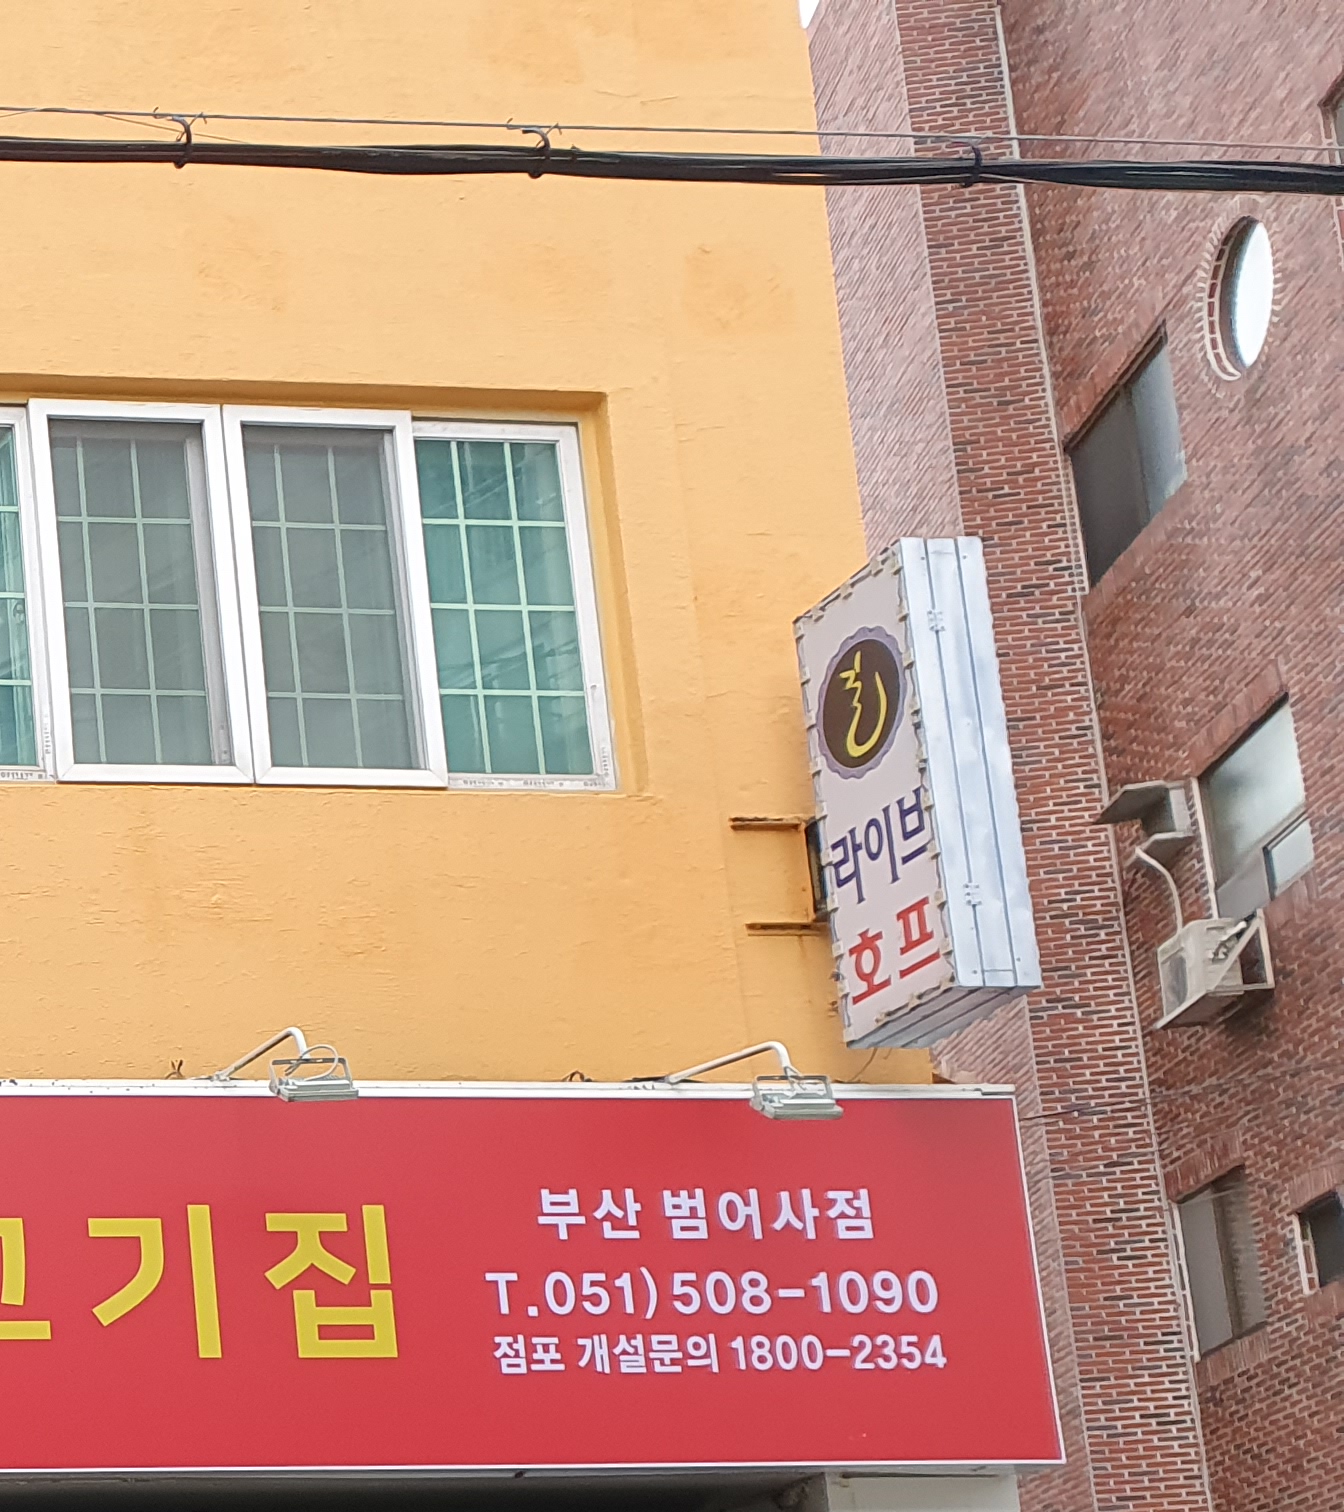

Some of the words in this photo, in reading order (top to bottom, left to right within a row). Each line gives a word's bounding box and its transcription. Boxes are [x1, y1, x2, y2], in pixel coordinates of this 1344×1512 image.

[829, 786, 930, 905] 라이브
[848, 896, 942, 1005] 호프
[537, 1187, 642, 1241] 부산
[661, 1187, 875, 1241] 범어사점
[492, 1333, 566, 1375] 점포
[576, 1333, 721, 1375] 개설문의
[730, 1333, 948, 1371] 1800-2354
